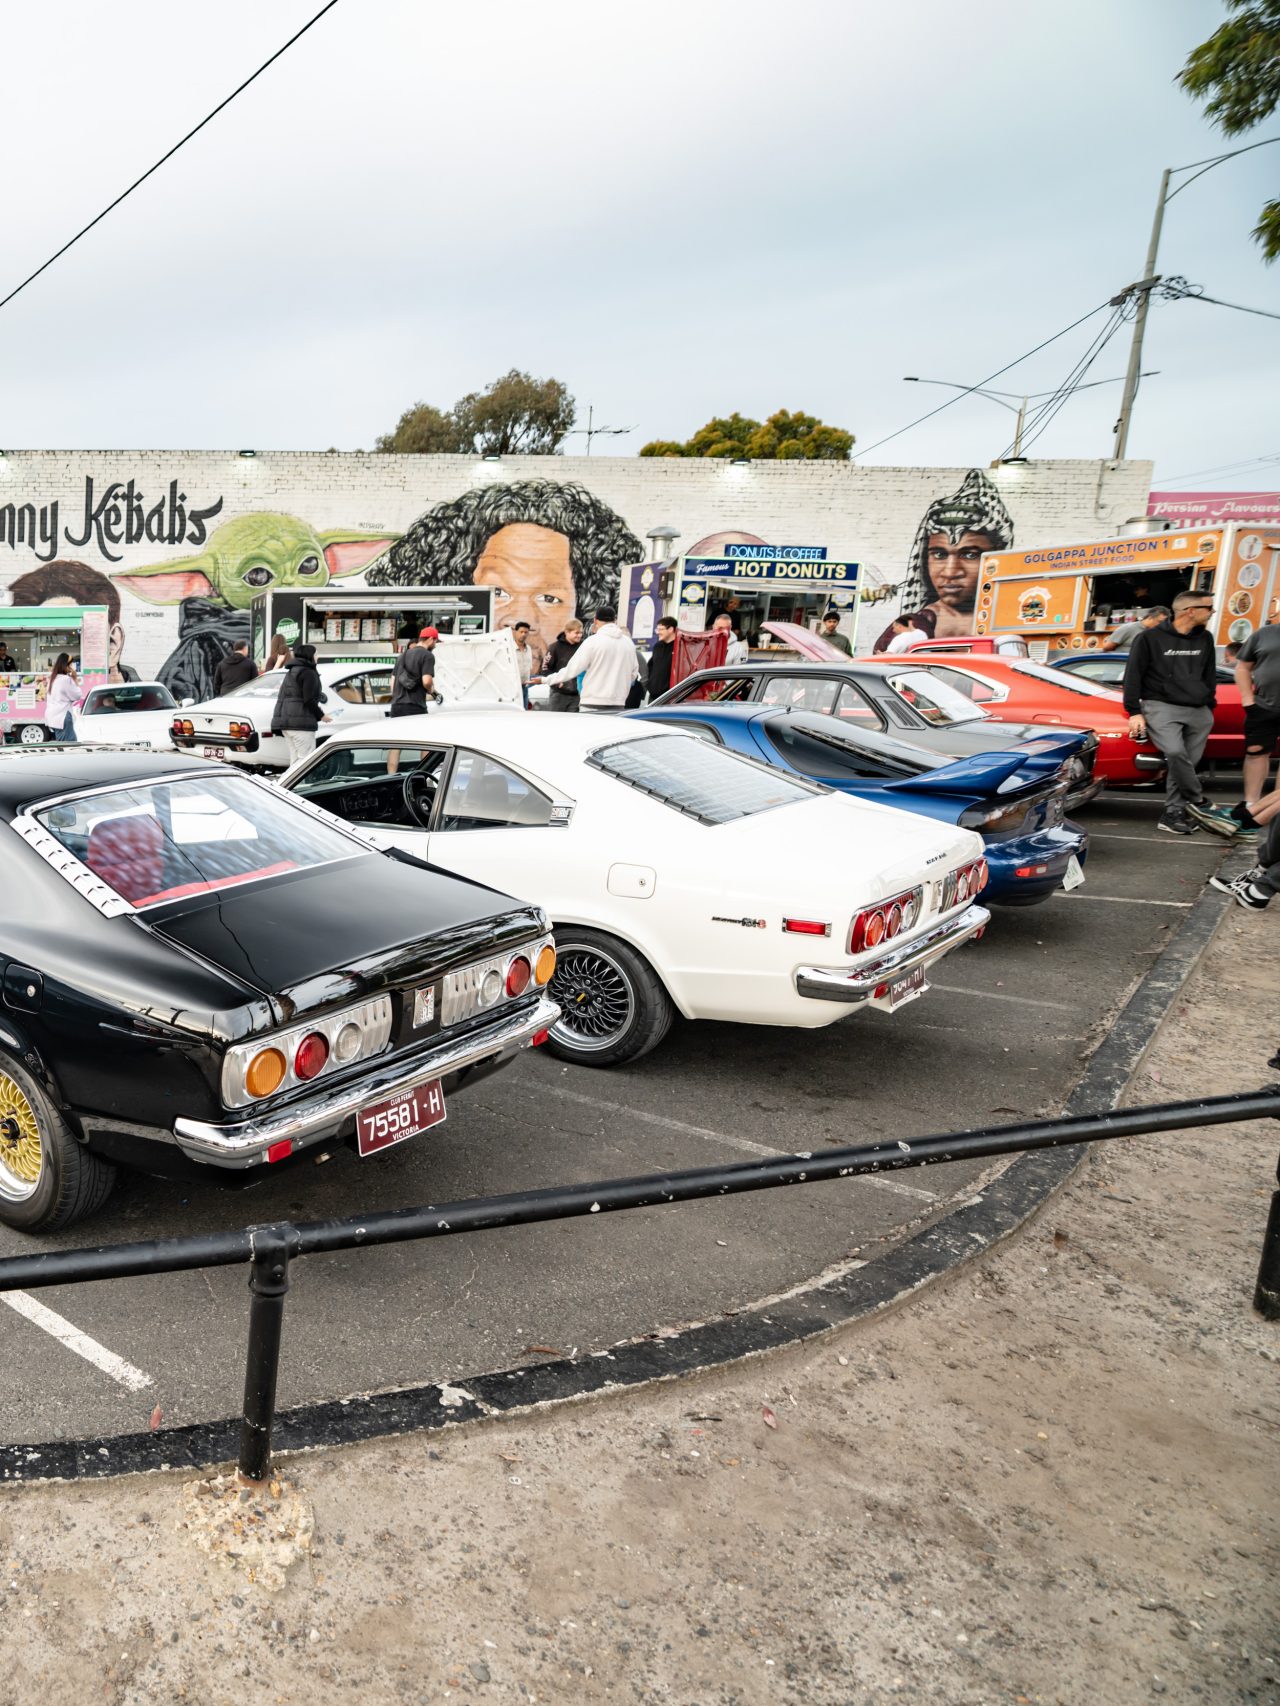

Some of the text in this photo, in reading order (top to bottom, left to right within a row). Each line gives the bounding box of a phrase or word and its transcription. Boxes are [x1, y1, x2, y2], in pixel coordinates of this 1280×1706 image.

[1153, 502, 1207, 516] Persian
[729, 545, 774, 558] DONUTS
[783, 548, 822, 560] COFFEE
[1024, 539, 1169, 564] GOLGAPPA JUNCTION 1
[1050, 554, 1135, 569] INDIAN STREET FOOD
[696, 561, 847, 579] Famous HOT DONUTS
[390, 1090, 415, 1106] CLUB PERMIT
[392, 1124, 420, 1141] VICTORIA
